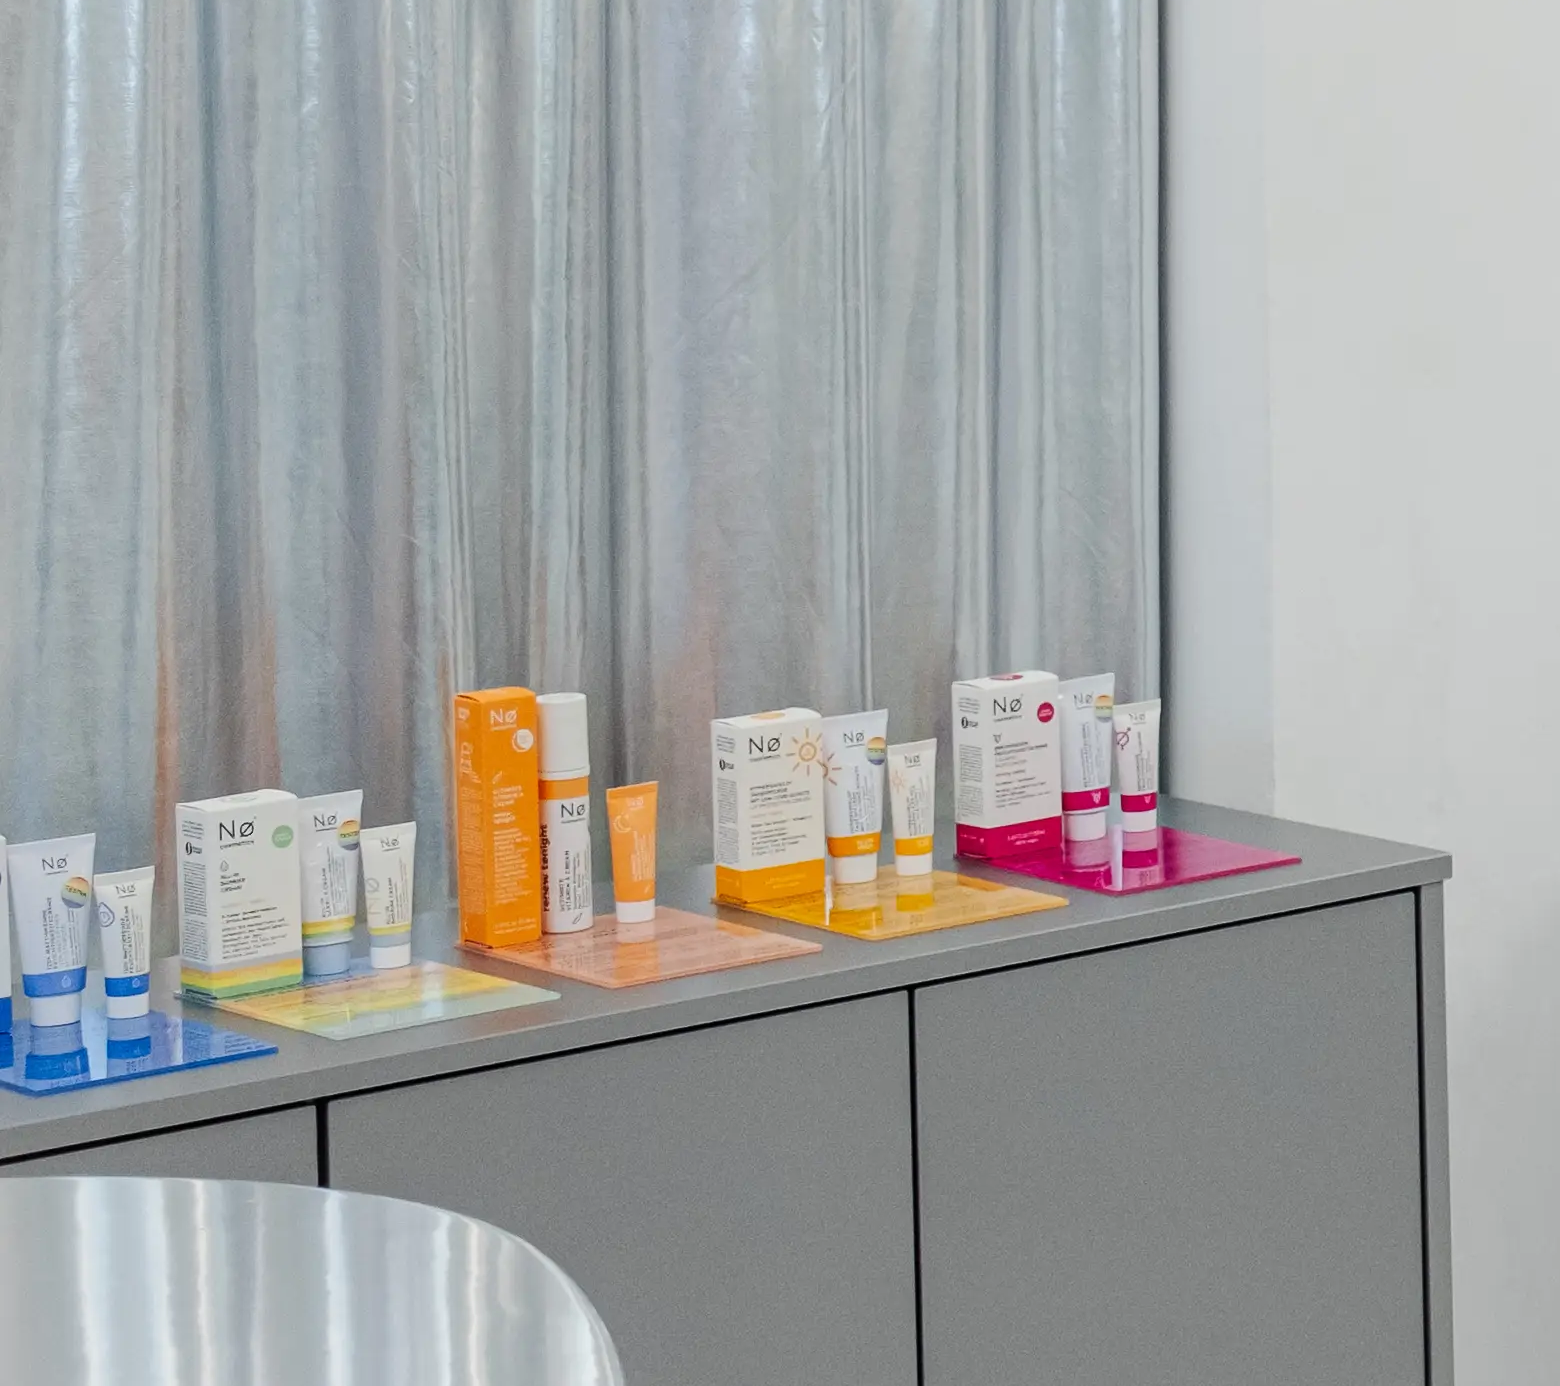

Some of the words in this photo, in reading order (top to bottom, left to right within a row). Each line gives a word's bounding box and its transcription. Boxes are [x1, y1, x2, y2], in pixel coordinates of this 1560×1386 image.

[993, 696, 1023, 715] Nø
[749, 735, 781, 754] Nø
[219, 819, 255, 841] Nø
[42, 857, 68, 871] Nø
